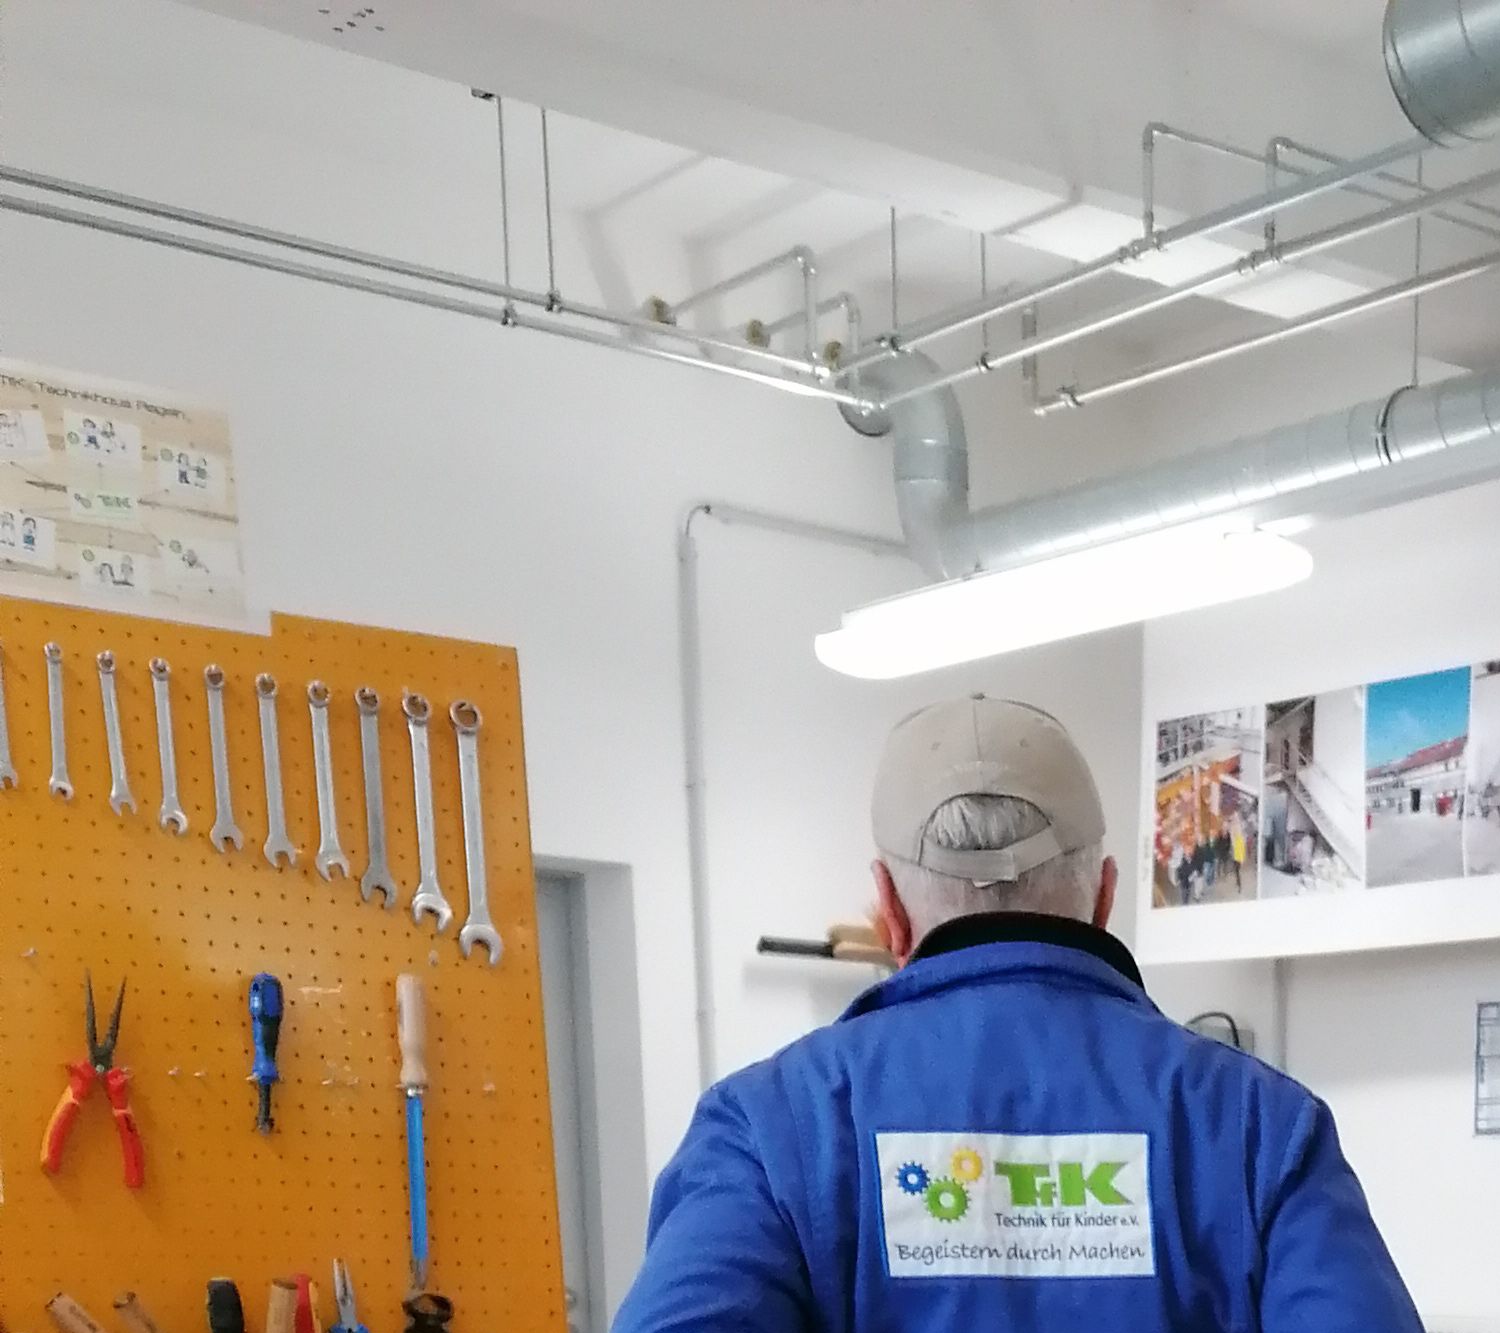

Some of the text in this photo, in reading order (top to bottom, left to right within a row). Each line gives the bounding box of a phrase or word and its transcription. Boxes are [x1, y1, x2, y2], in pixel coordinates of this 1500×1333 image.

[995, 1211, 1139, 1227] Technik für Kinder e.V.
[896, 1239, 1146, 1265] Begeistern durch Machen
